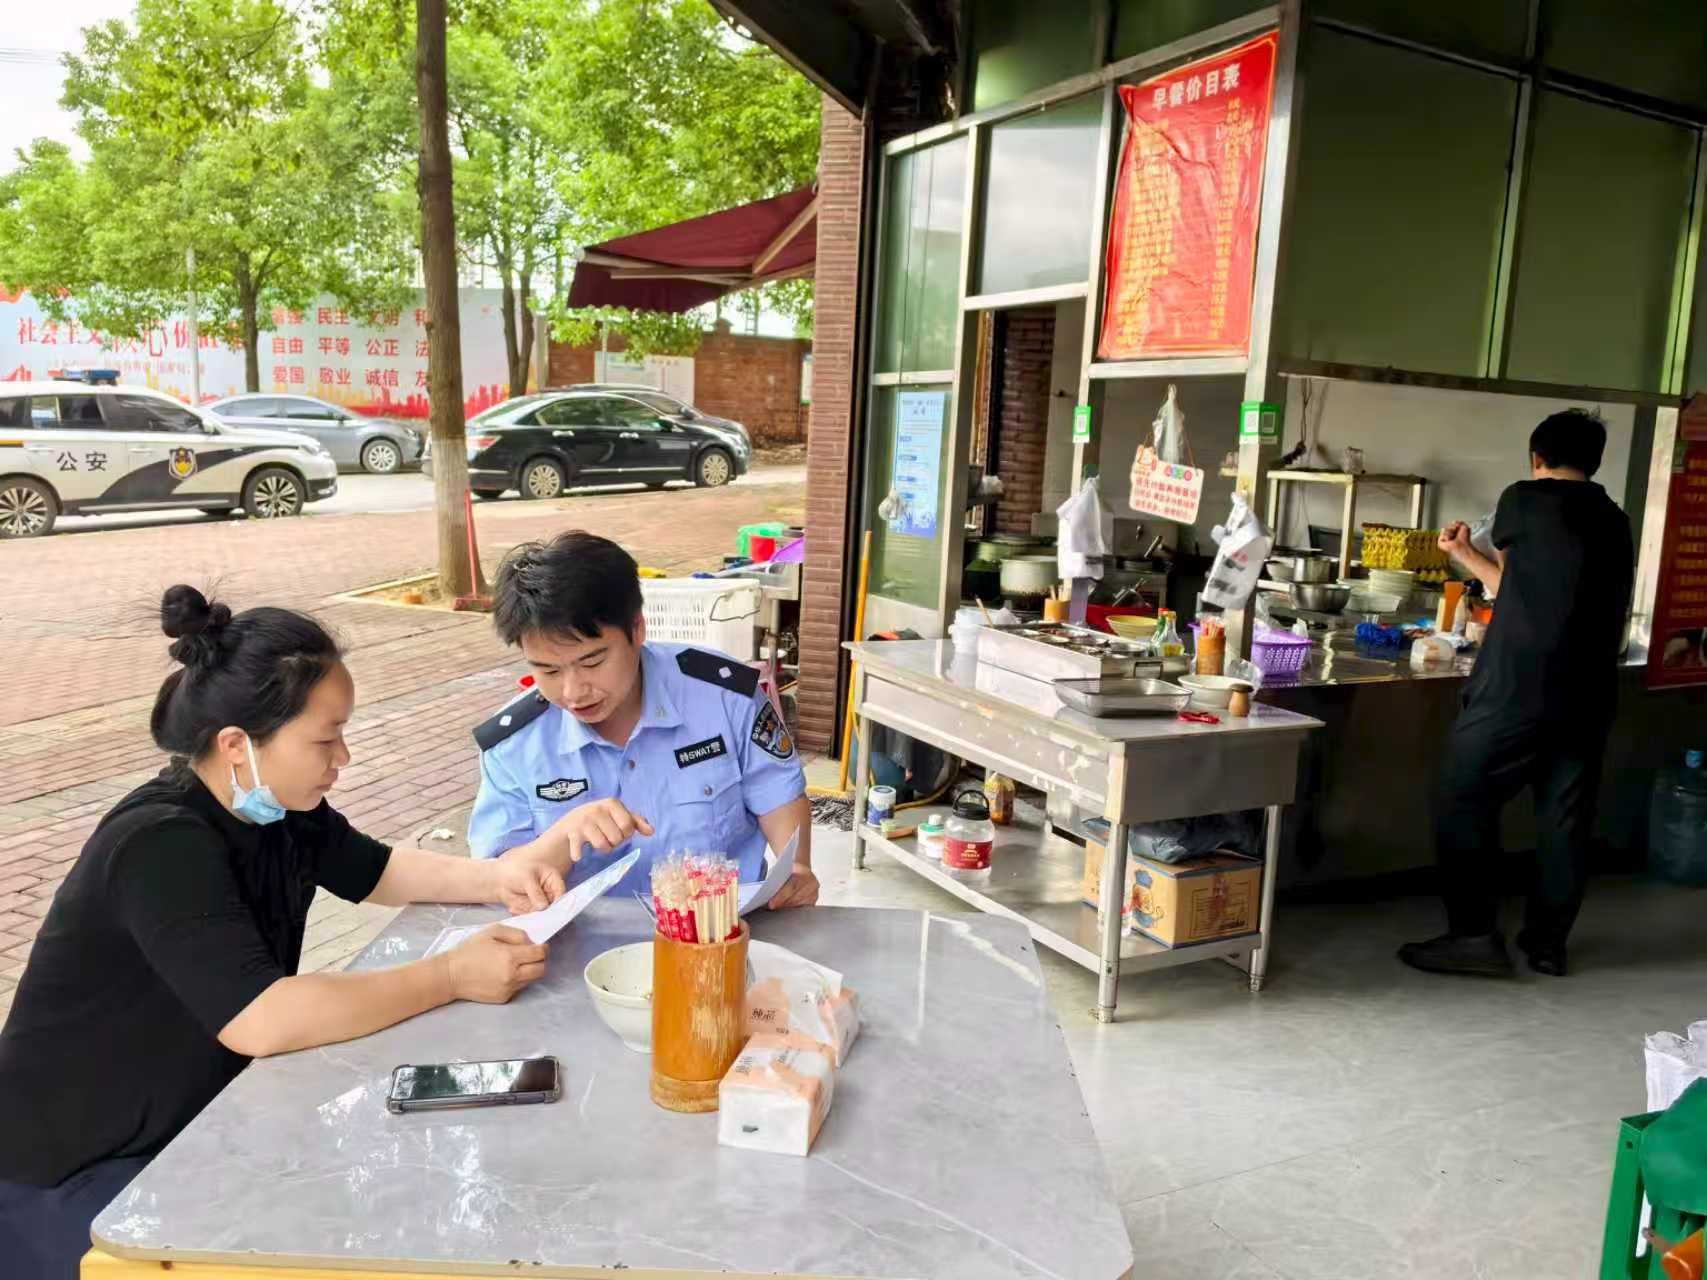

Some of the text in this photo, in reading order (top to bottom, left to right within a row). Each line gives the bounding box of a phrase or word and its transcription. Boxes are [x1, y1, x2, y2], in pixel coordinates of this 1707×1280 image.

[1152, 63, 1241, 112] 早餐价目表
[272, 337, 304, 355] 自由
[318, 337, 350, 356] 平等
[366, 338, 399, 357] 公正
[273, 366, 305, 385] 爱国
[319, 366, 351, 385] 敬业
[365, 368, 399, 387] 诚信
[56, 450, 107, 471] 公安
